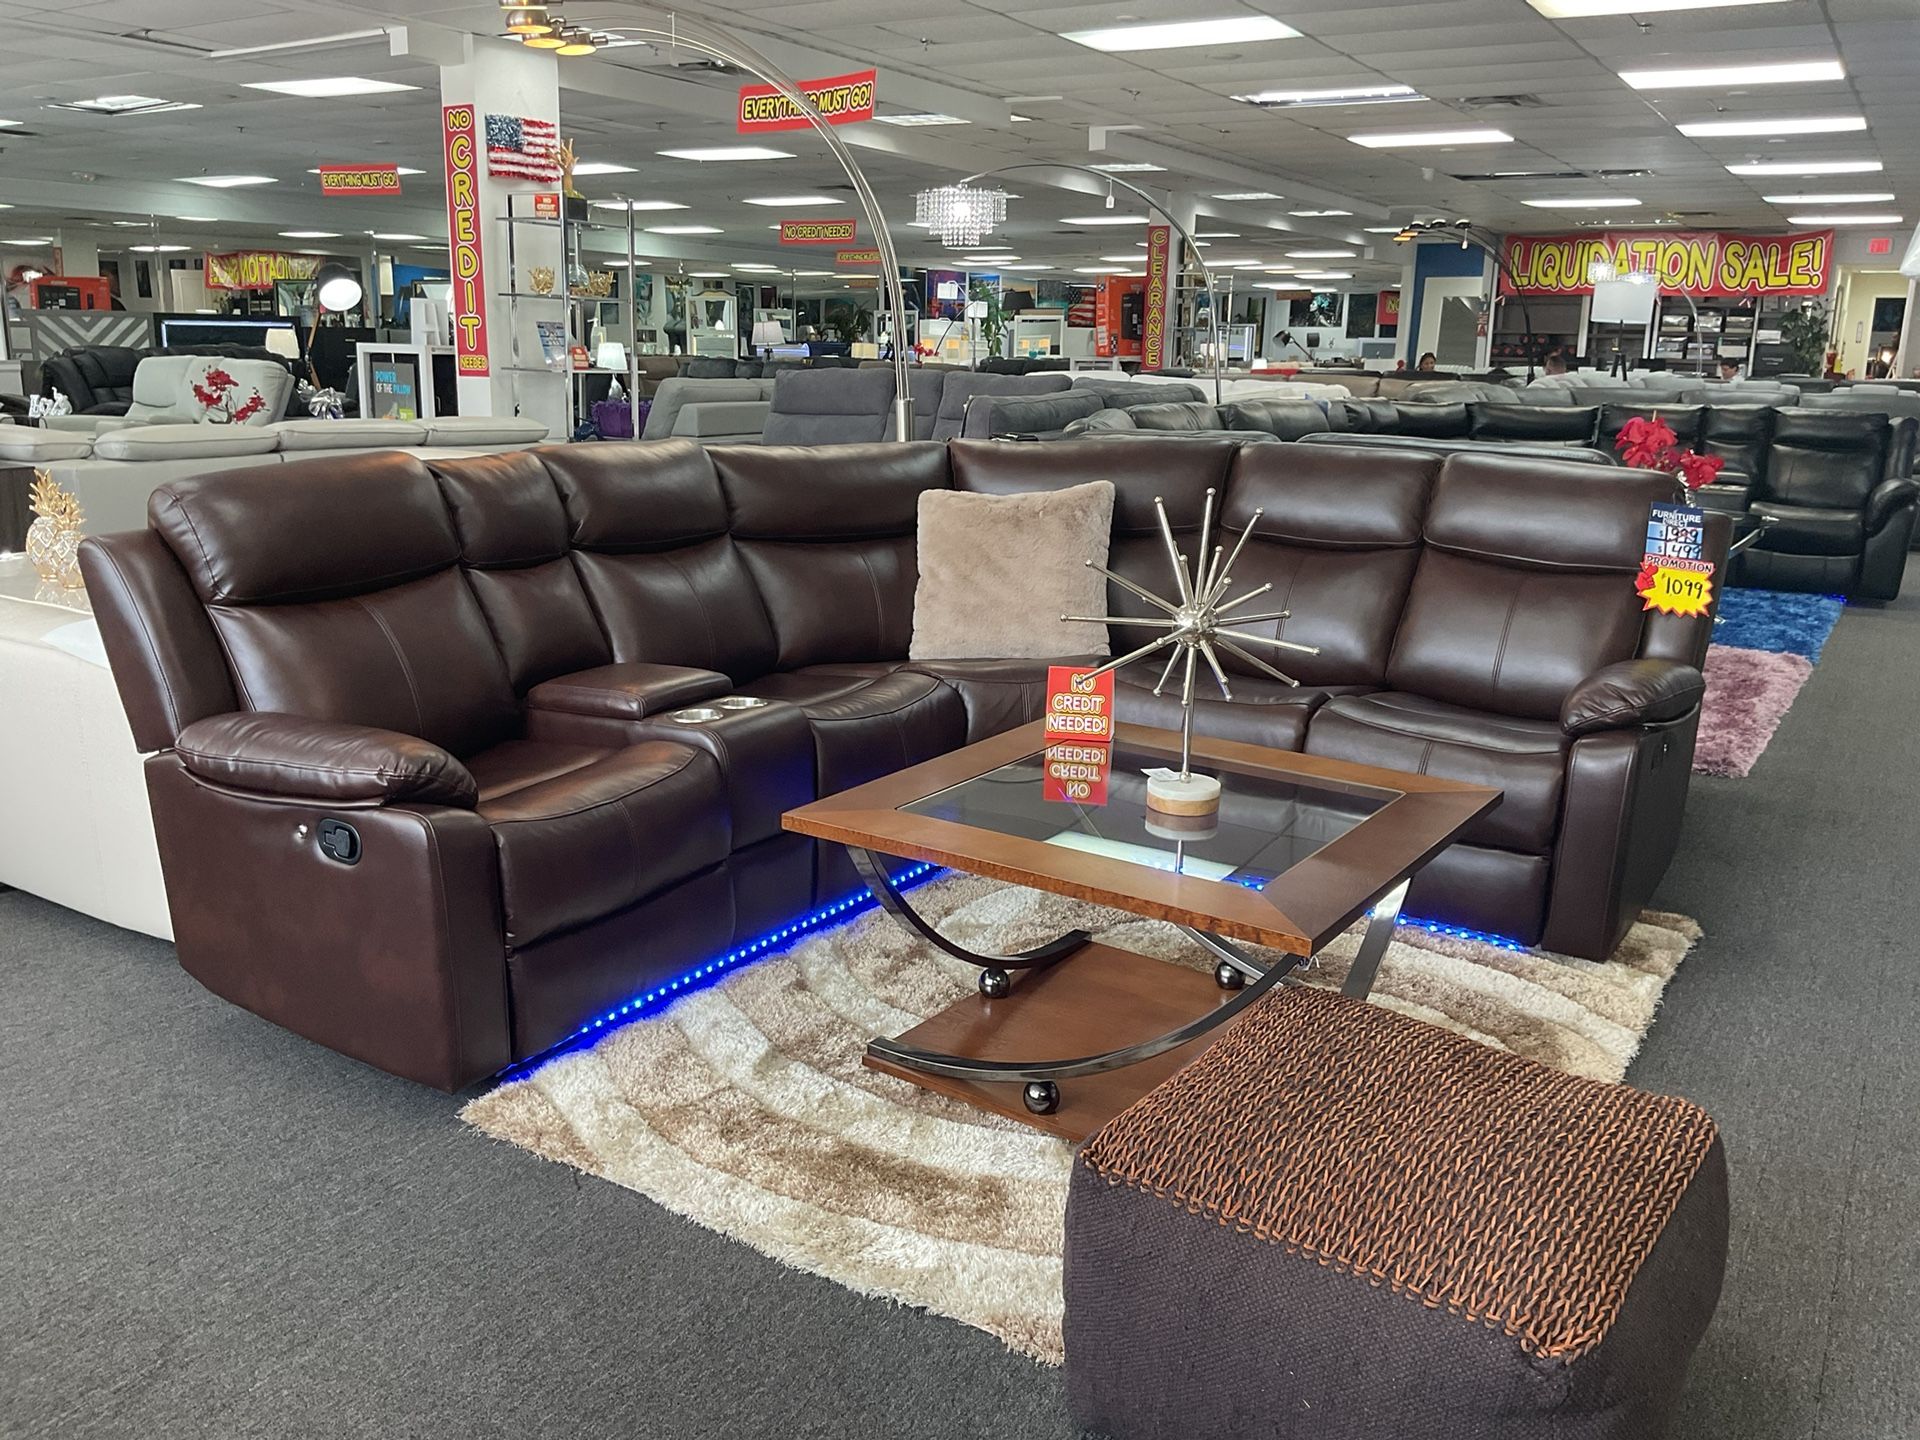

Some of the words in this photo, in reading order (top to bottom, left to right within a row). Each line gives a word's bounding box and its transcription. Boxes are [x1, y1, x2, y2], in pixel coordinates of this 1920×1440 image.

[743, 93, 819, 119] EVERYTH
[819, 88, 850, 113] MUST
[850, 84, 872, 109] GO!
[448, 110, 471, 129] NO
[323, 173, 361, 187] EVERYTHING
[361, 172, 381, 187] MUST
[382, 172, 398, 187] GO!
[784, 225, 796, 238] NO
[798, 225, 822, 238] CREDIT
[823, 224, 853, 238] NEEDED!
[450, 135, 480, 350] CREDIT
[1511, 240, 1717, 289] LIQUIDATION
[1719, 238, 1824, 290] SALE!
[1146, 229, 1167, 366] CLEARANCE
[376, 371, 396, 382] POWER
[376, 383, 383, 393] OF
[383, 383, 392, 394] THE
[1652, 509, 1702, 523] FURNITURE
[1646, 556, 1712, 573] PROMOTION
[1071, 674, 1096, 693] NO
[1052, 693, 1105, 714] CREDIT
[1047, 714, 1108, 735] NEEDED!
